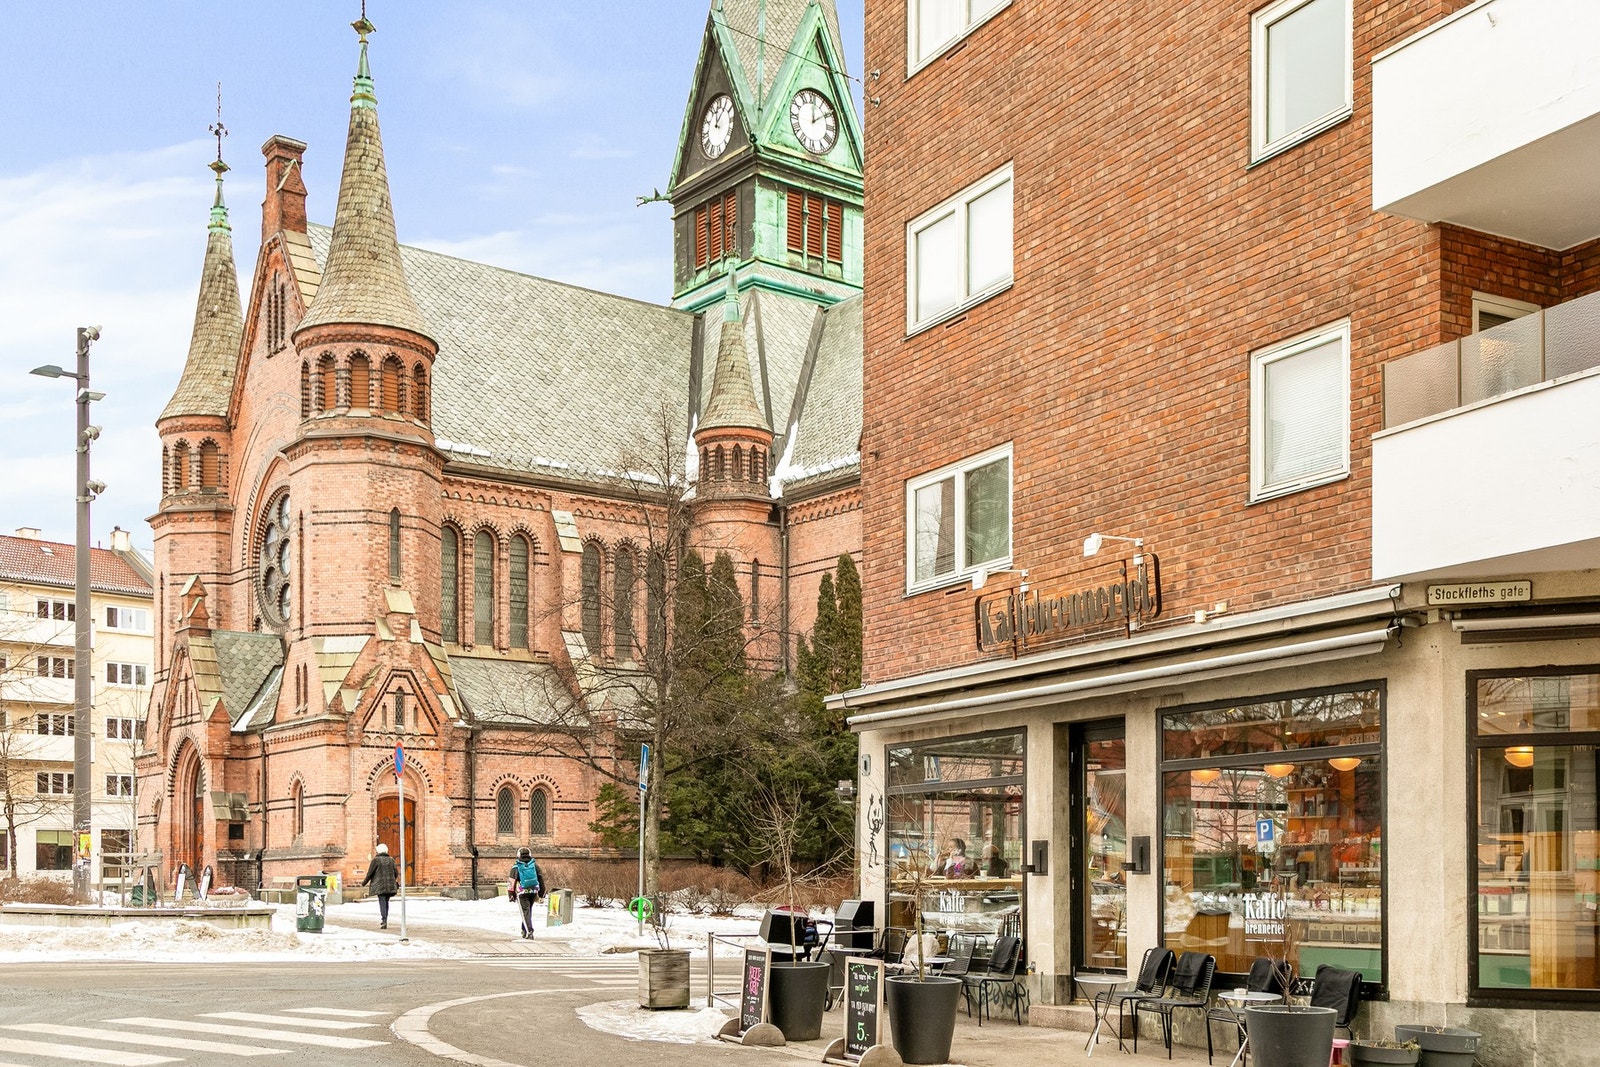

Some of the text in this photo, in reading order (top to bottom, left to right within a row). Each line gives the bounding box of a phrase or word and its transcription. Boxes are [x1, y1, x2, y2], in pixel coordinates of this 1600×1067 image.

[1435, 585, 1524, 600] Stockfleths gate
[979, 562, 1156, 647] Kaffebrenneriet
[1261, 822, 1270, 839] P
[940, 890, 964, 912] Kaffe
[1244, 892, 1285, 919] Kaffe
[1245, 920, 1285, 934] brenneriet
